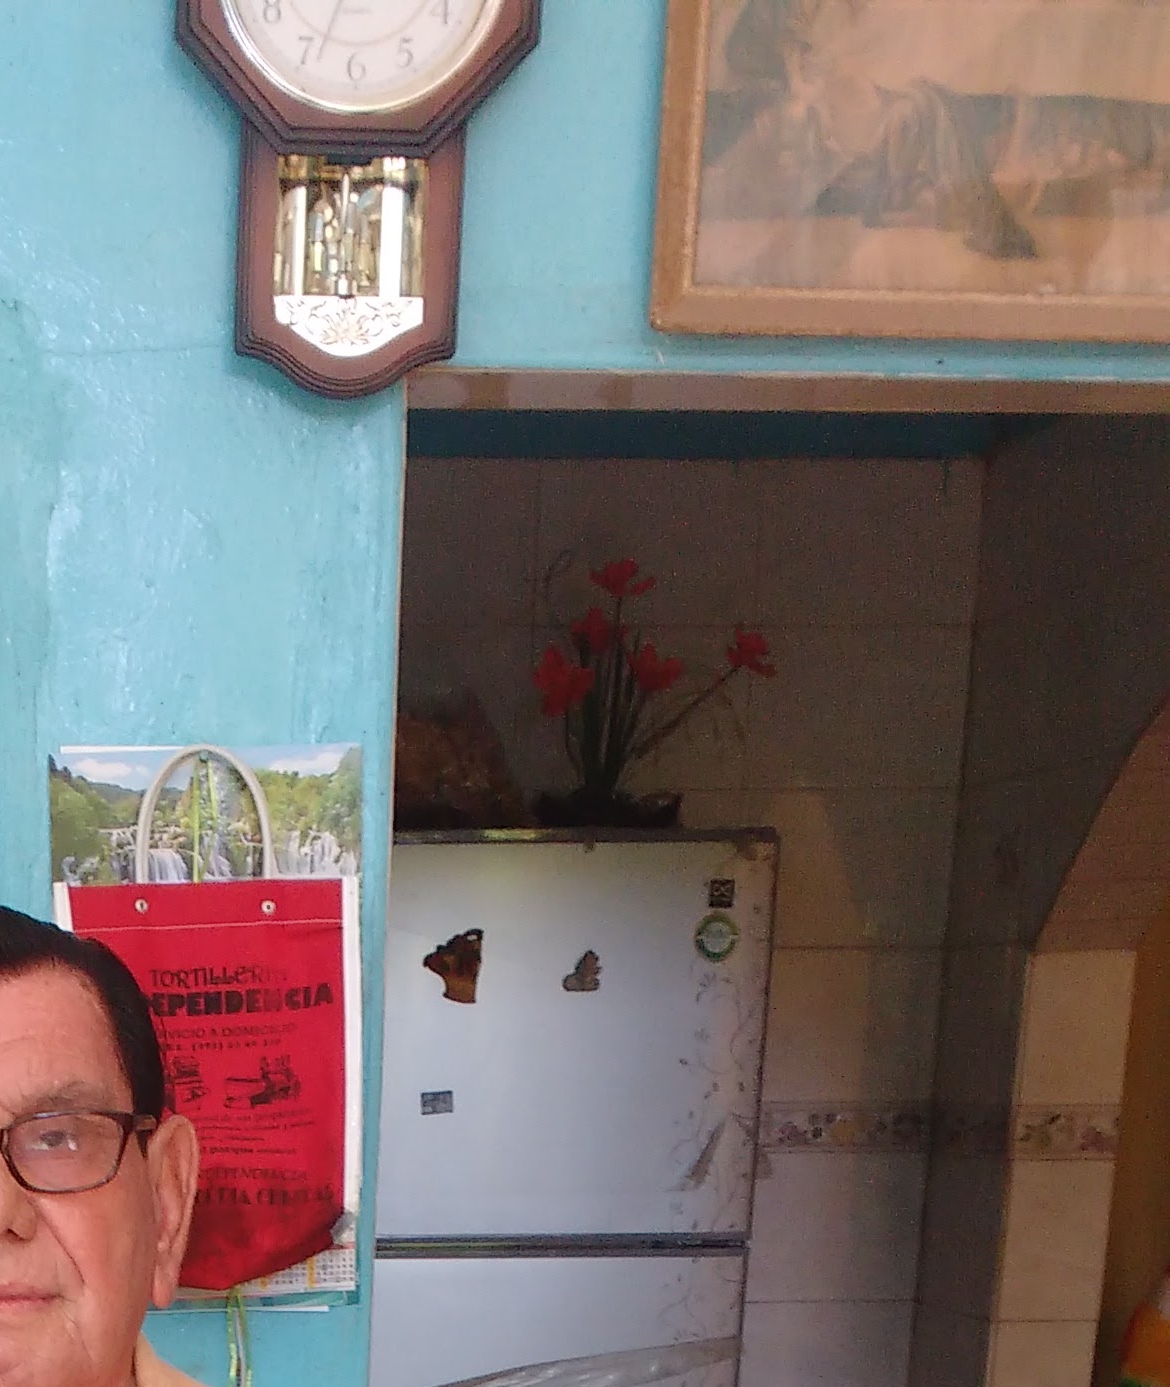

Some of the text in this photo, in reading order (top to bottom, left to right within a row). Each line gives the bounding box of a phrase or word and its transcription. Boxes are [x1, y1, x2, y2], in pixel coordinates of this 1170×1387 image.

[297, 35, 315, 65] 7
[397, 37, 414, 68] 5
[346, 52, 367, 82] 6
[149, 982, 334, 1017] EPENDENCIA
